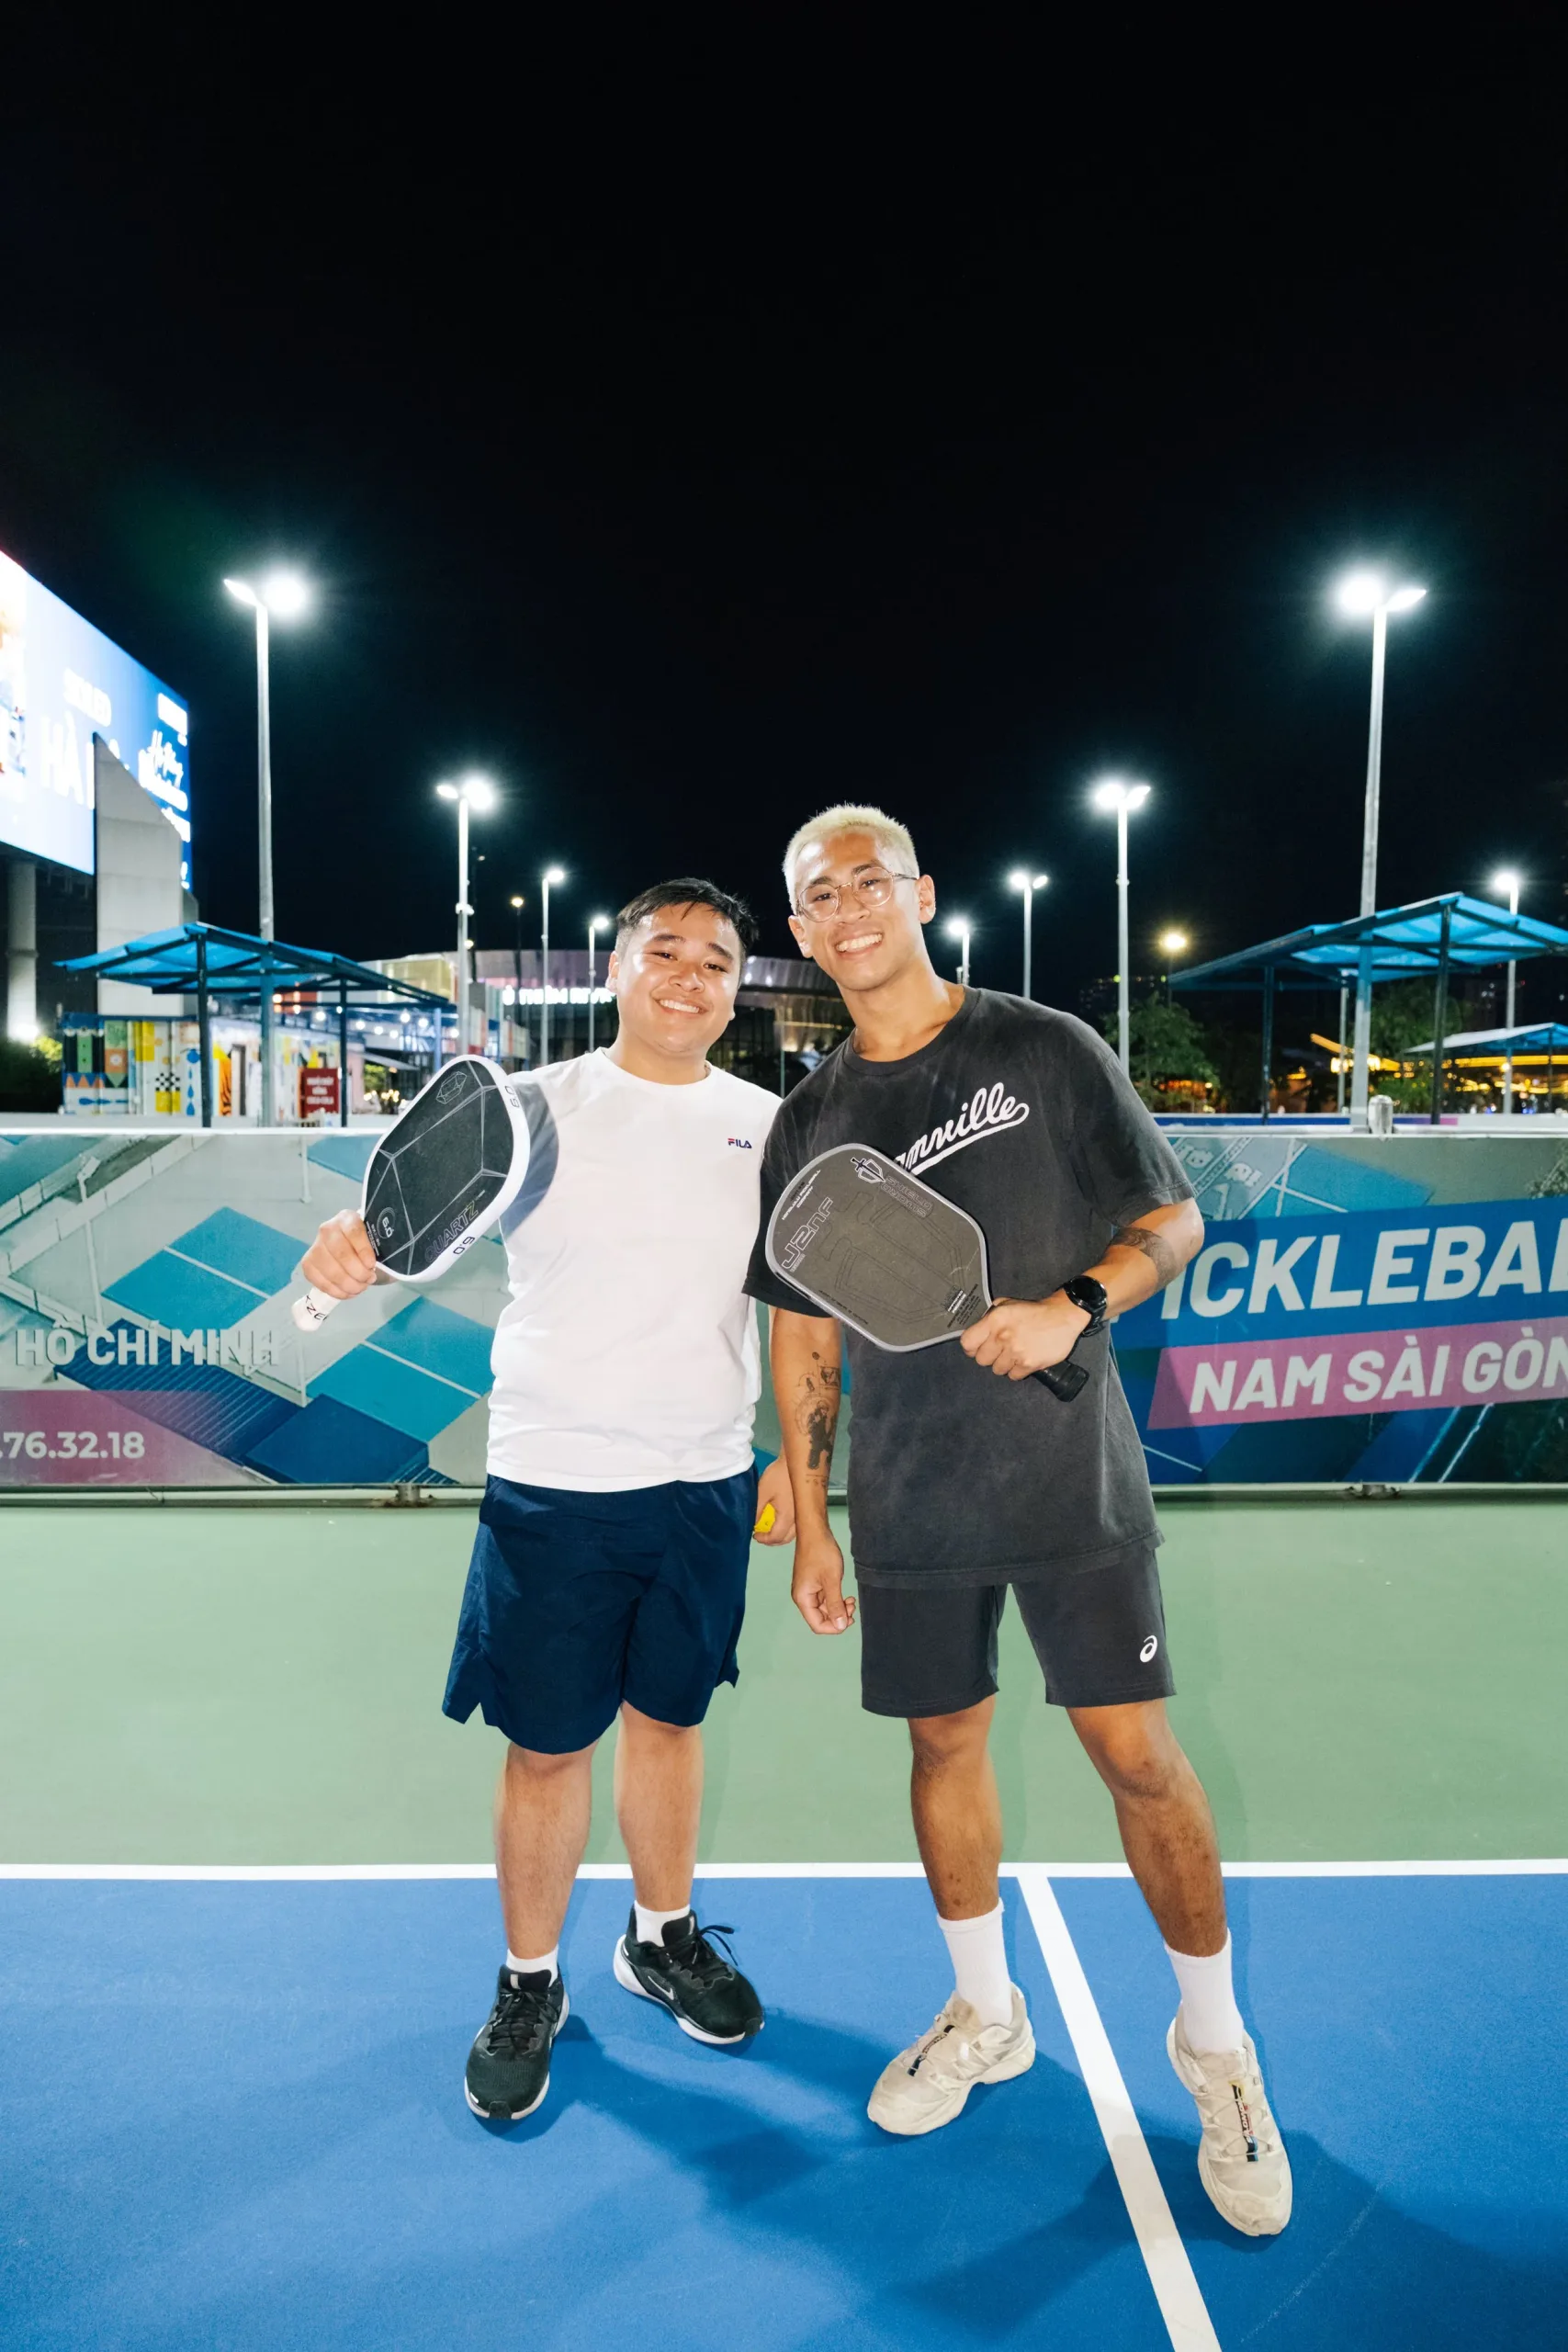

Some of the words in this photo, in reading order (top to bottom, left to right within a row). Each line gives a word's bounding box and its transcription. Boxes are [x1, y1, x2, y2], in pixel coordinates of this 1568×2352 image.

[728, 1137, 752, 1148] FILA
[881, 1182, 927, 1218] SWORD
[381, 1216, 395, 1238] 6.0
[424, 1200, 479, 1263] QUARTZ
[1109, 1218, 1568, 1324] ICKLEBA
[87, 1319, 160, 1366] CHÍ
[171, 1329, 278, 1366] MINH
[1189, 1353, 1332, 1414] NAM
[1343, 1335, 1450, 1403] SÀI
